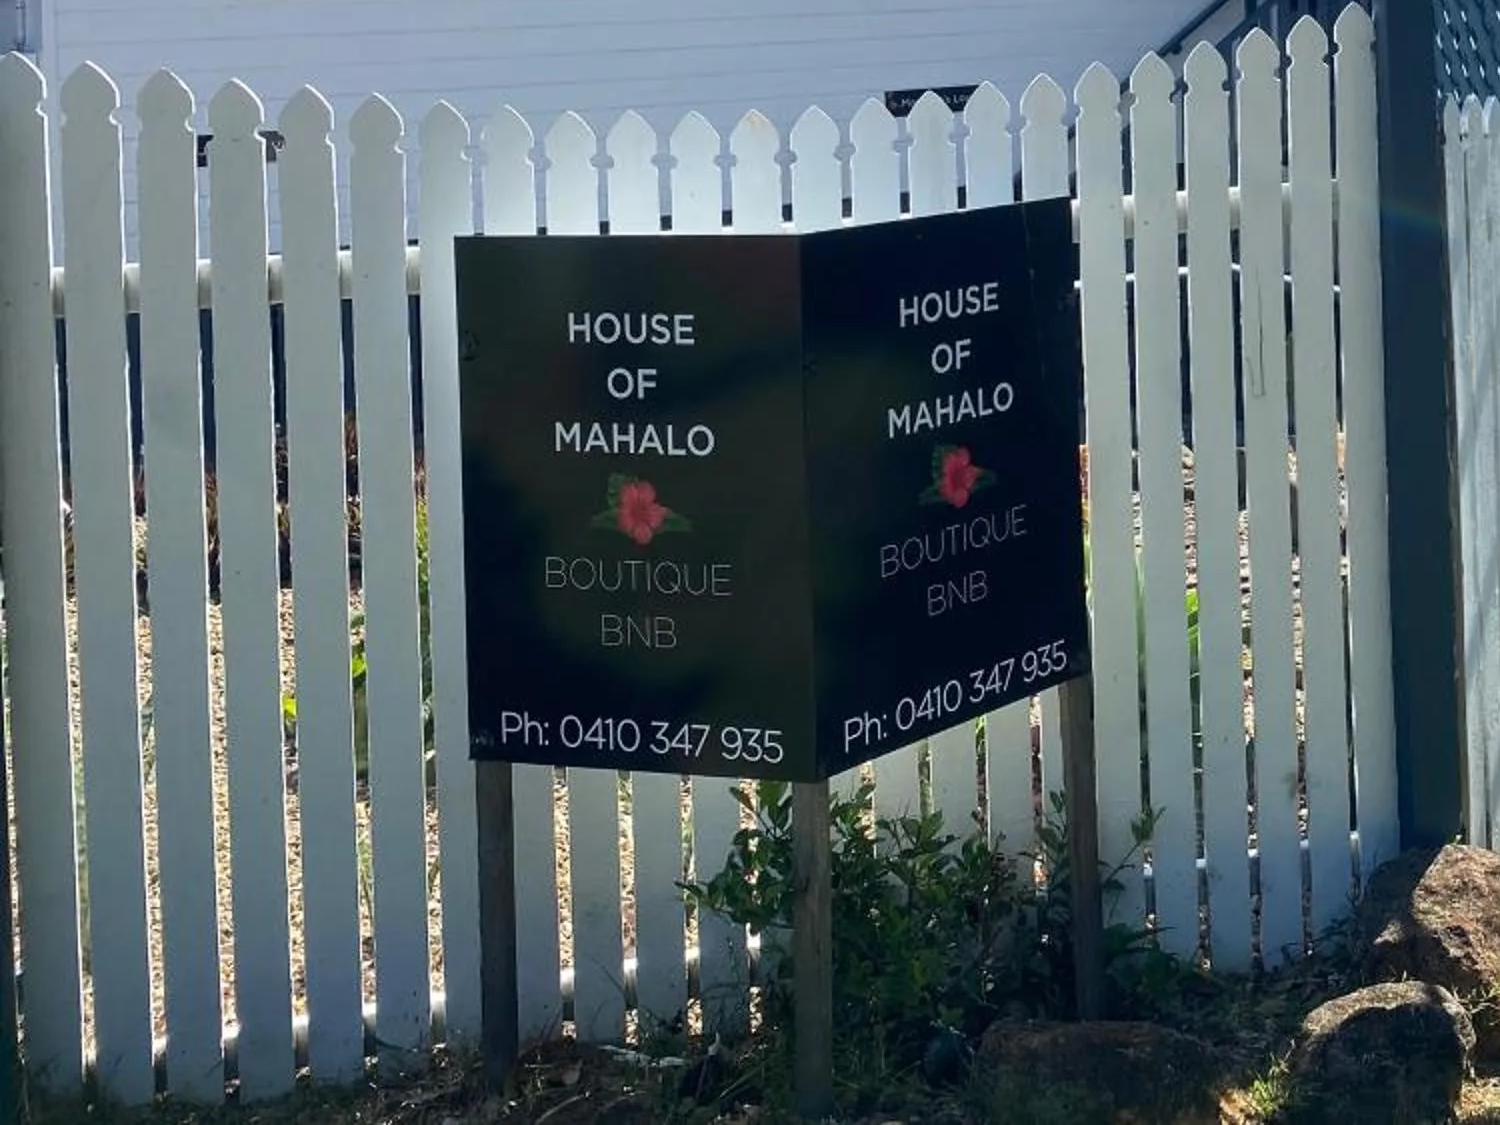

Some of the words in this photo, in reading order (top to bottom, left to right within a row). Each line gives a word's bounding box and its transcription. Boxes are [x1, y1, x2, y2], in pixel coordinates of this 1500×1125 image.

[899, 282, 999, 328] HOUSE
[568, 313, 695, 345] HOUSE
[931, 339, 971, 374] OF
[607, 368, 657, 399] OF
[888, 382, 1014, 439] MAHALO
[555, 422, 715, 456] MAHALO
[880, 505, 1027, 578] BOUTIQUE
[545, 557, 732, 596] BOUTIQUE
[927, 571, 988, 616] BNB
[601, 615, 677, 648] BNB
[844, 711, 889, 753] Ph:
[896, 680, 962, 733] 0410
[969, 658, 1016, 705] 347
[1022, 640, 1068, 679] 935
[501, 712, 549, 746] Ph:
[559, 715, 641, 752] 0410
[650, 722, 710, 757] 347
[721, 727, 784, 763] 935
